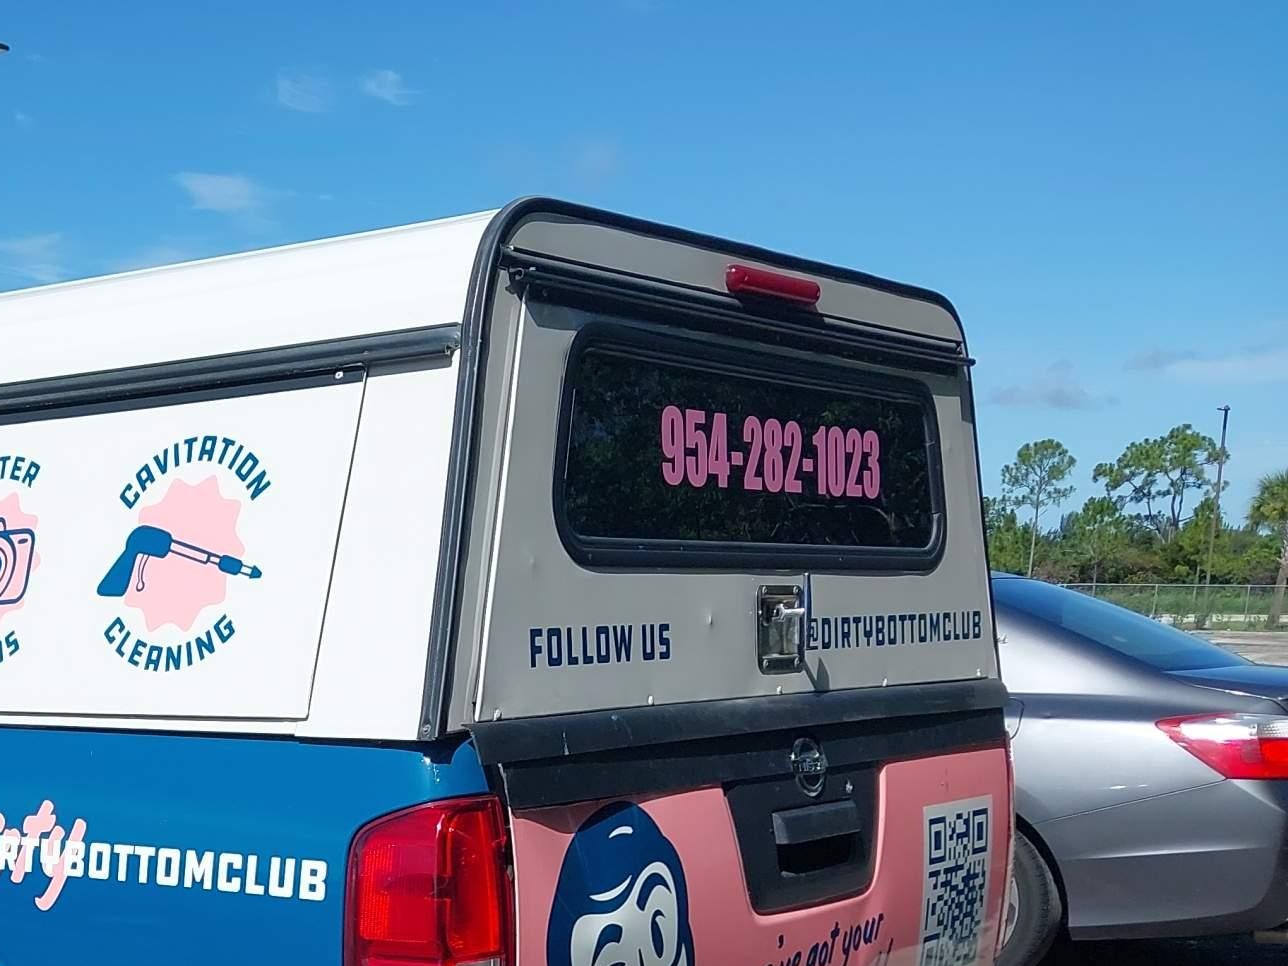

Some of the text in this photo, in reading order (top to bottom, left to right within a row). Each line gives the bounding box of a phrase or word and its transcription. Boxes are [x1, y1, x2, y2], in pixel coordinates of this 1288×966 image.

[119, 435, 271, 509] CAVITATION
[661, 405, 881, 499] 954-282-1023
[103, 614, 236, 672] CLEANING
[529, 623, 671, 669] FOLLOW US
[807, 610, 982, 651] @DIRTYBOTTOMCLUB
